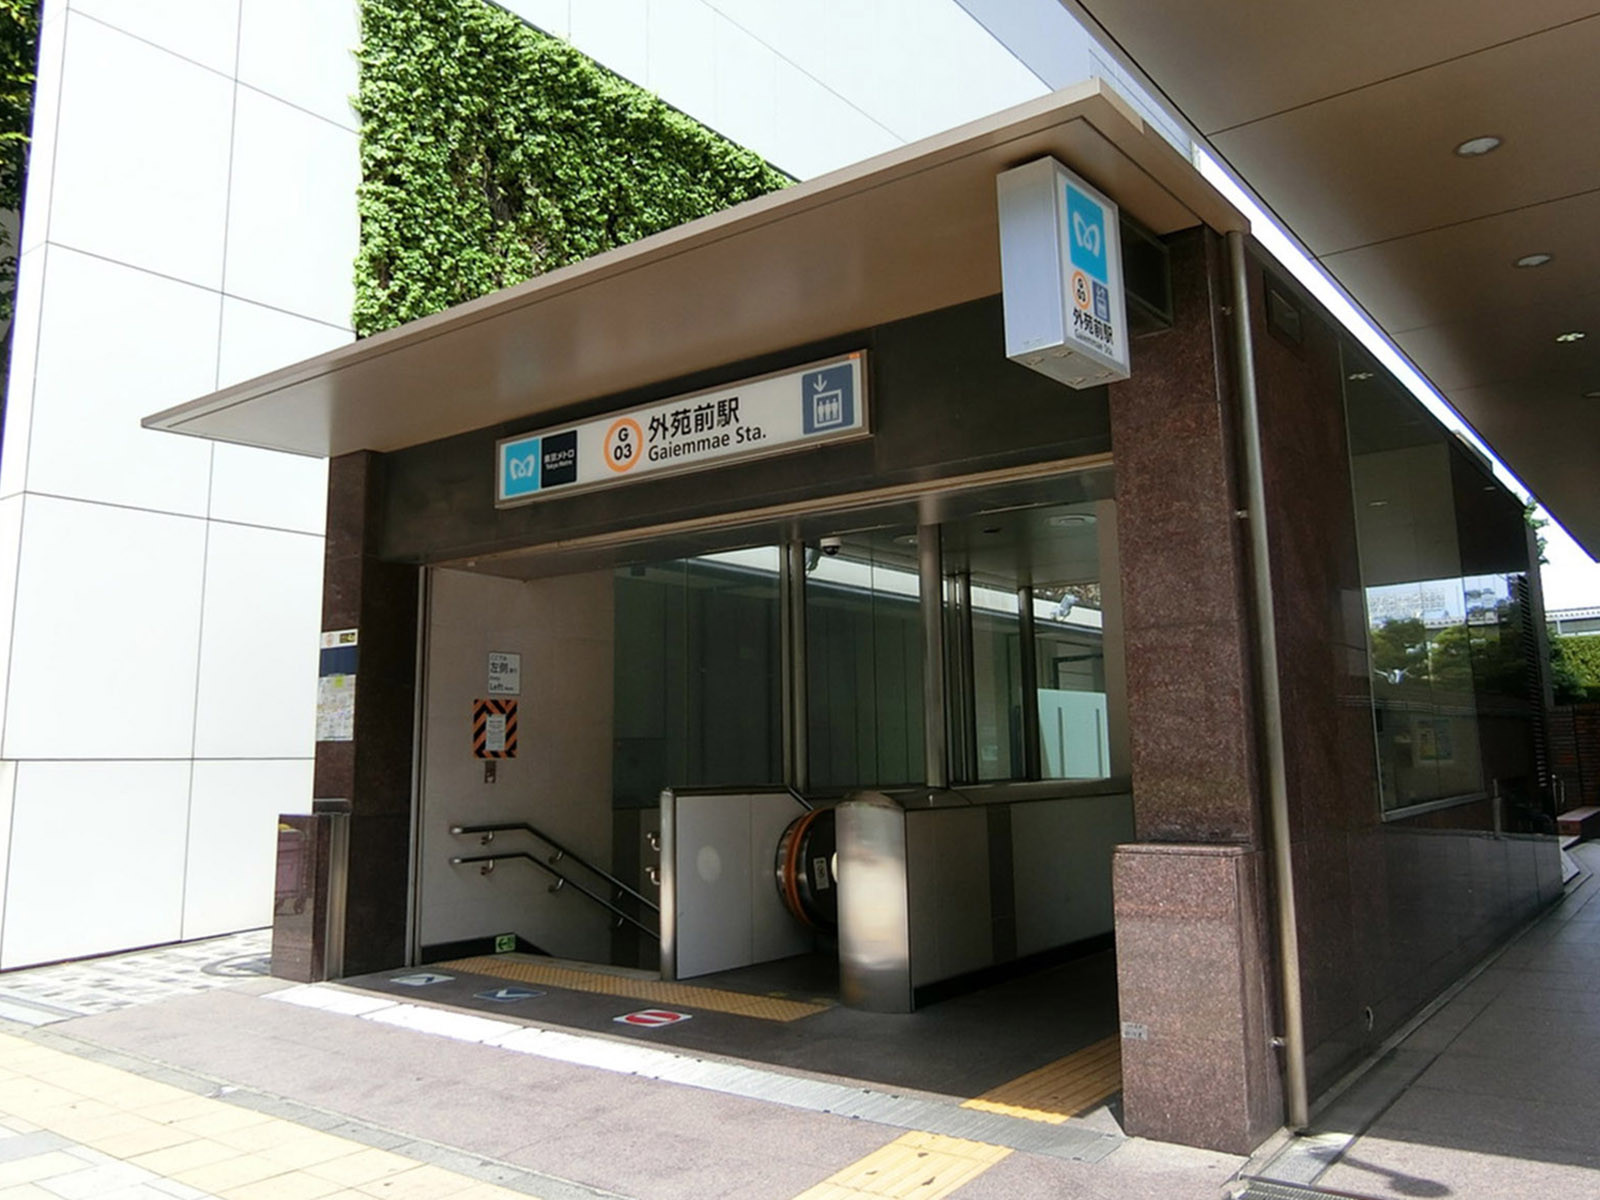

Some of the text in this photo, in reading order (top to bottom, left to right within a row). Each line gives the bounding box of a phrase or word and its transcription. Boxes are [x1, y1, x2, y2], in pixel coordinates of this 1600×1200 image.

[1073, 306, 1115, 346] 外苑前駅
[648, 396, 740, 443] 外苑前駅
[617, 427, 629, 442] G
[648, 426, 767, 462] Gaiemmae Sta.
[544, 448, 575, 463] 東京メトロ
[613, 443, 633, 461] 03
